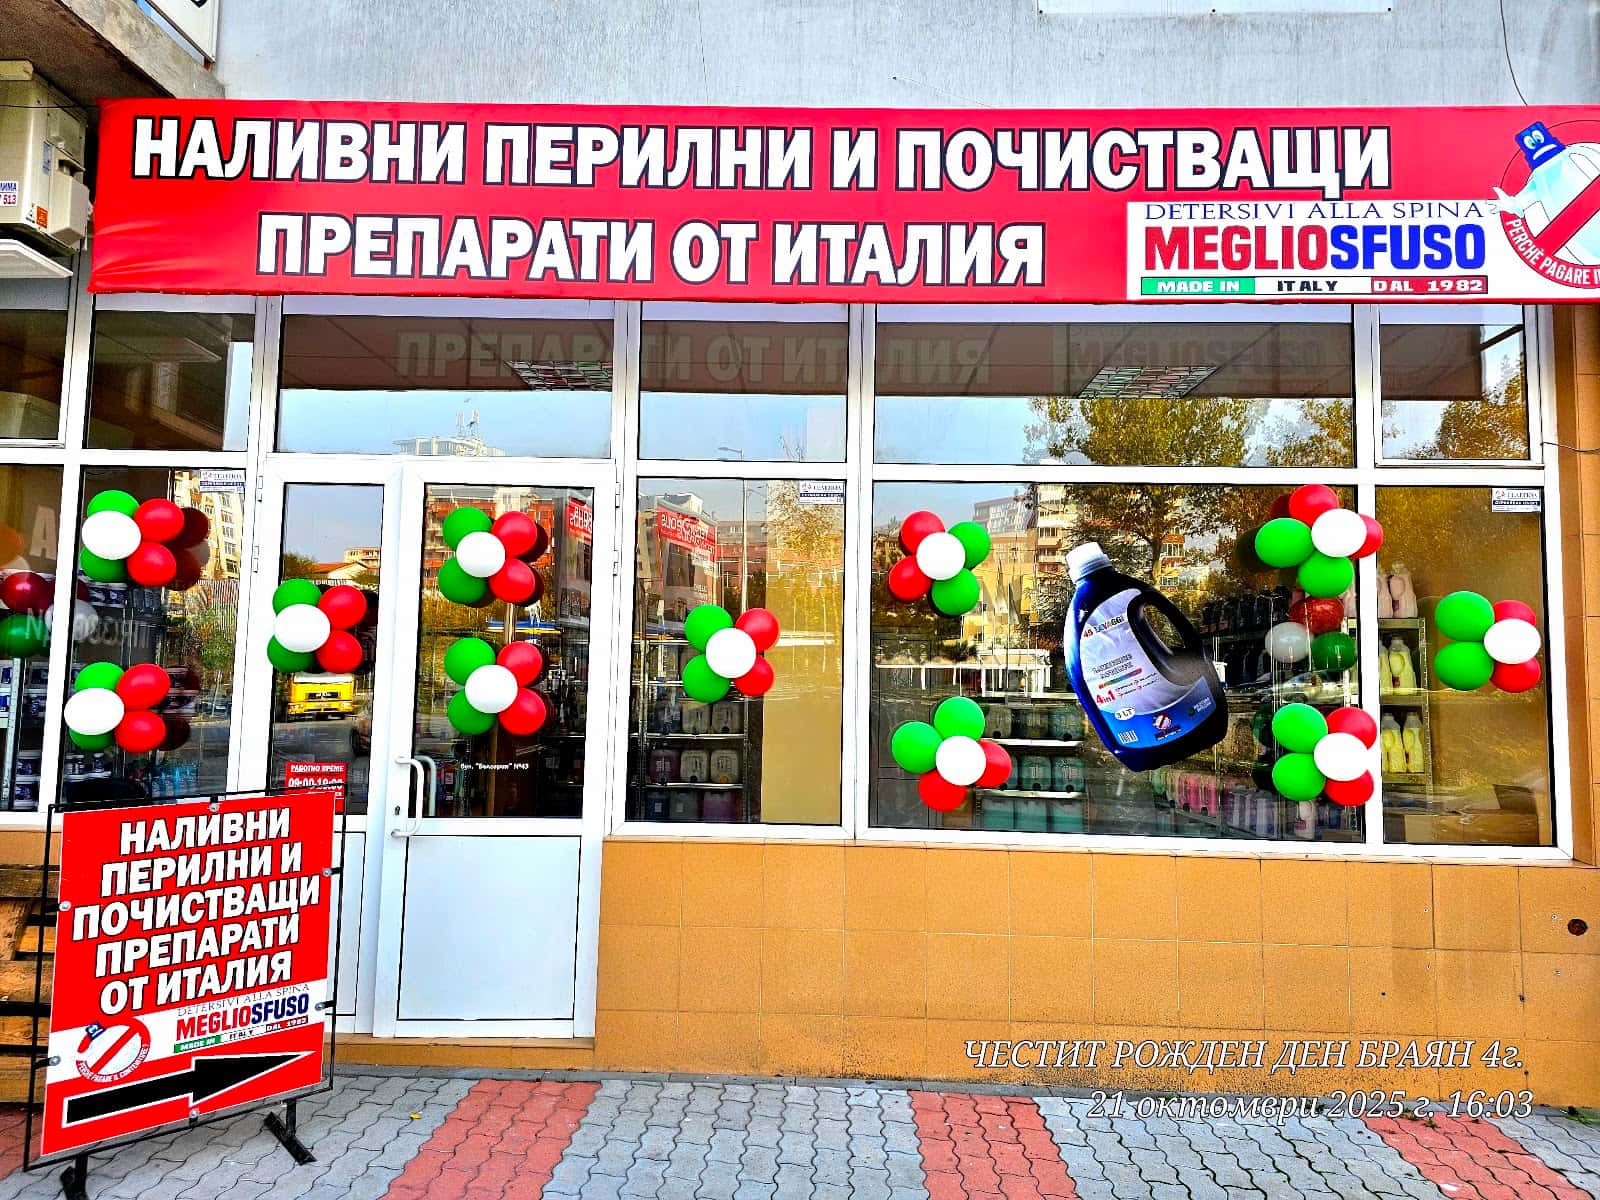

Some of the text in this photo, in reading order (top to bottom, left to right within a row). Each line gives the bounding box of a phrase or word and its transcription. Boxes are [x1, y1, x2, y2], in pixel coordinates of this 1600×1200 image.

[132, 116, 467, 183] НАЛИВНИ
[484, 121, 813, 189] ПЕРИЛНИ
[831, 127, 877, 189] И
[897, 126, 1391, 199] ПОЧИСТВАЩИ
[1145, 202, 1484, 220] DETERSIVI ALLA SPINA
[257, 212, 1045, 286] ПРЕПАРАТИ ОТ ИТАЛИЯ
[1145, 223, 1486, 271] MEGLIOSFUSO
[1539, 256, 1591, 285] PAGARE
[1157, 280, 1483, 293] MADE IN ITALY DAL 1982
[1096, 689, 1116, 704] 4in1
[290, 764, 345, 773] РАБОТНО ВРЕМЕ
[119, 807, 291, 856] НАЛИВНИ
[100, 842, 303, 898] ПЕРИЛНИ И
[71, 875, 321, 941] ПОЧИСТВАЩИ
[95, 912, 300, 978] ПРЕПАРАТИ
[99, 950, 293, 1016] ОТ ИТАЛИЯ
[178, 983, 310, 1017] DETERSIVI ALLA SPINA
[176, 993, 310, 1041] MEGLIOSFUSO
